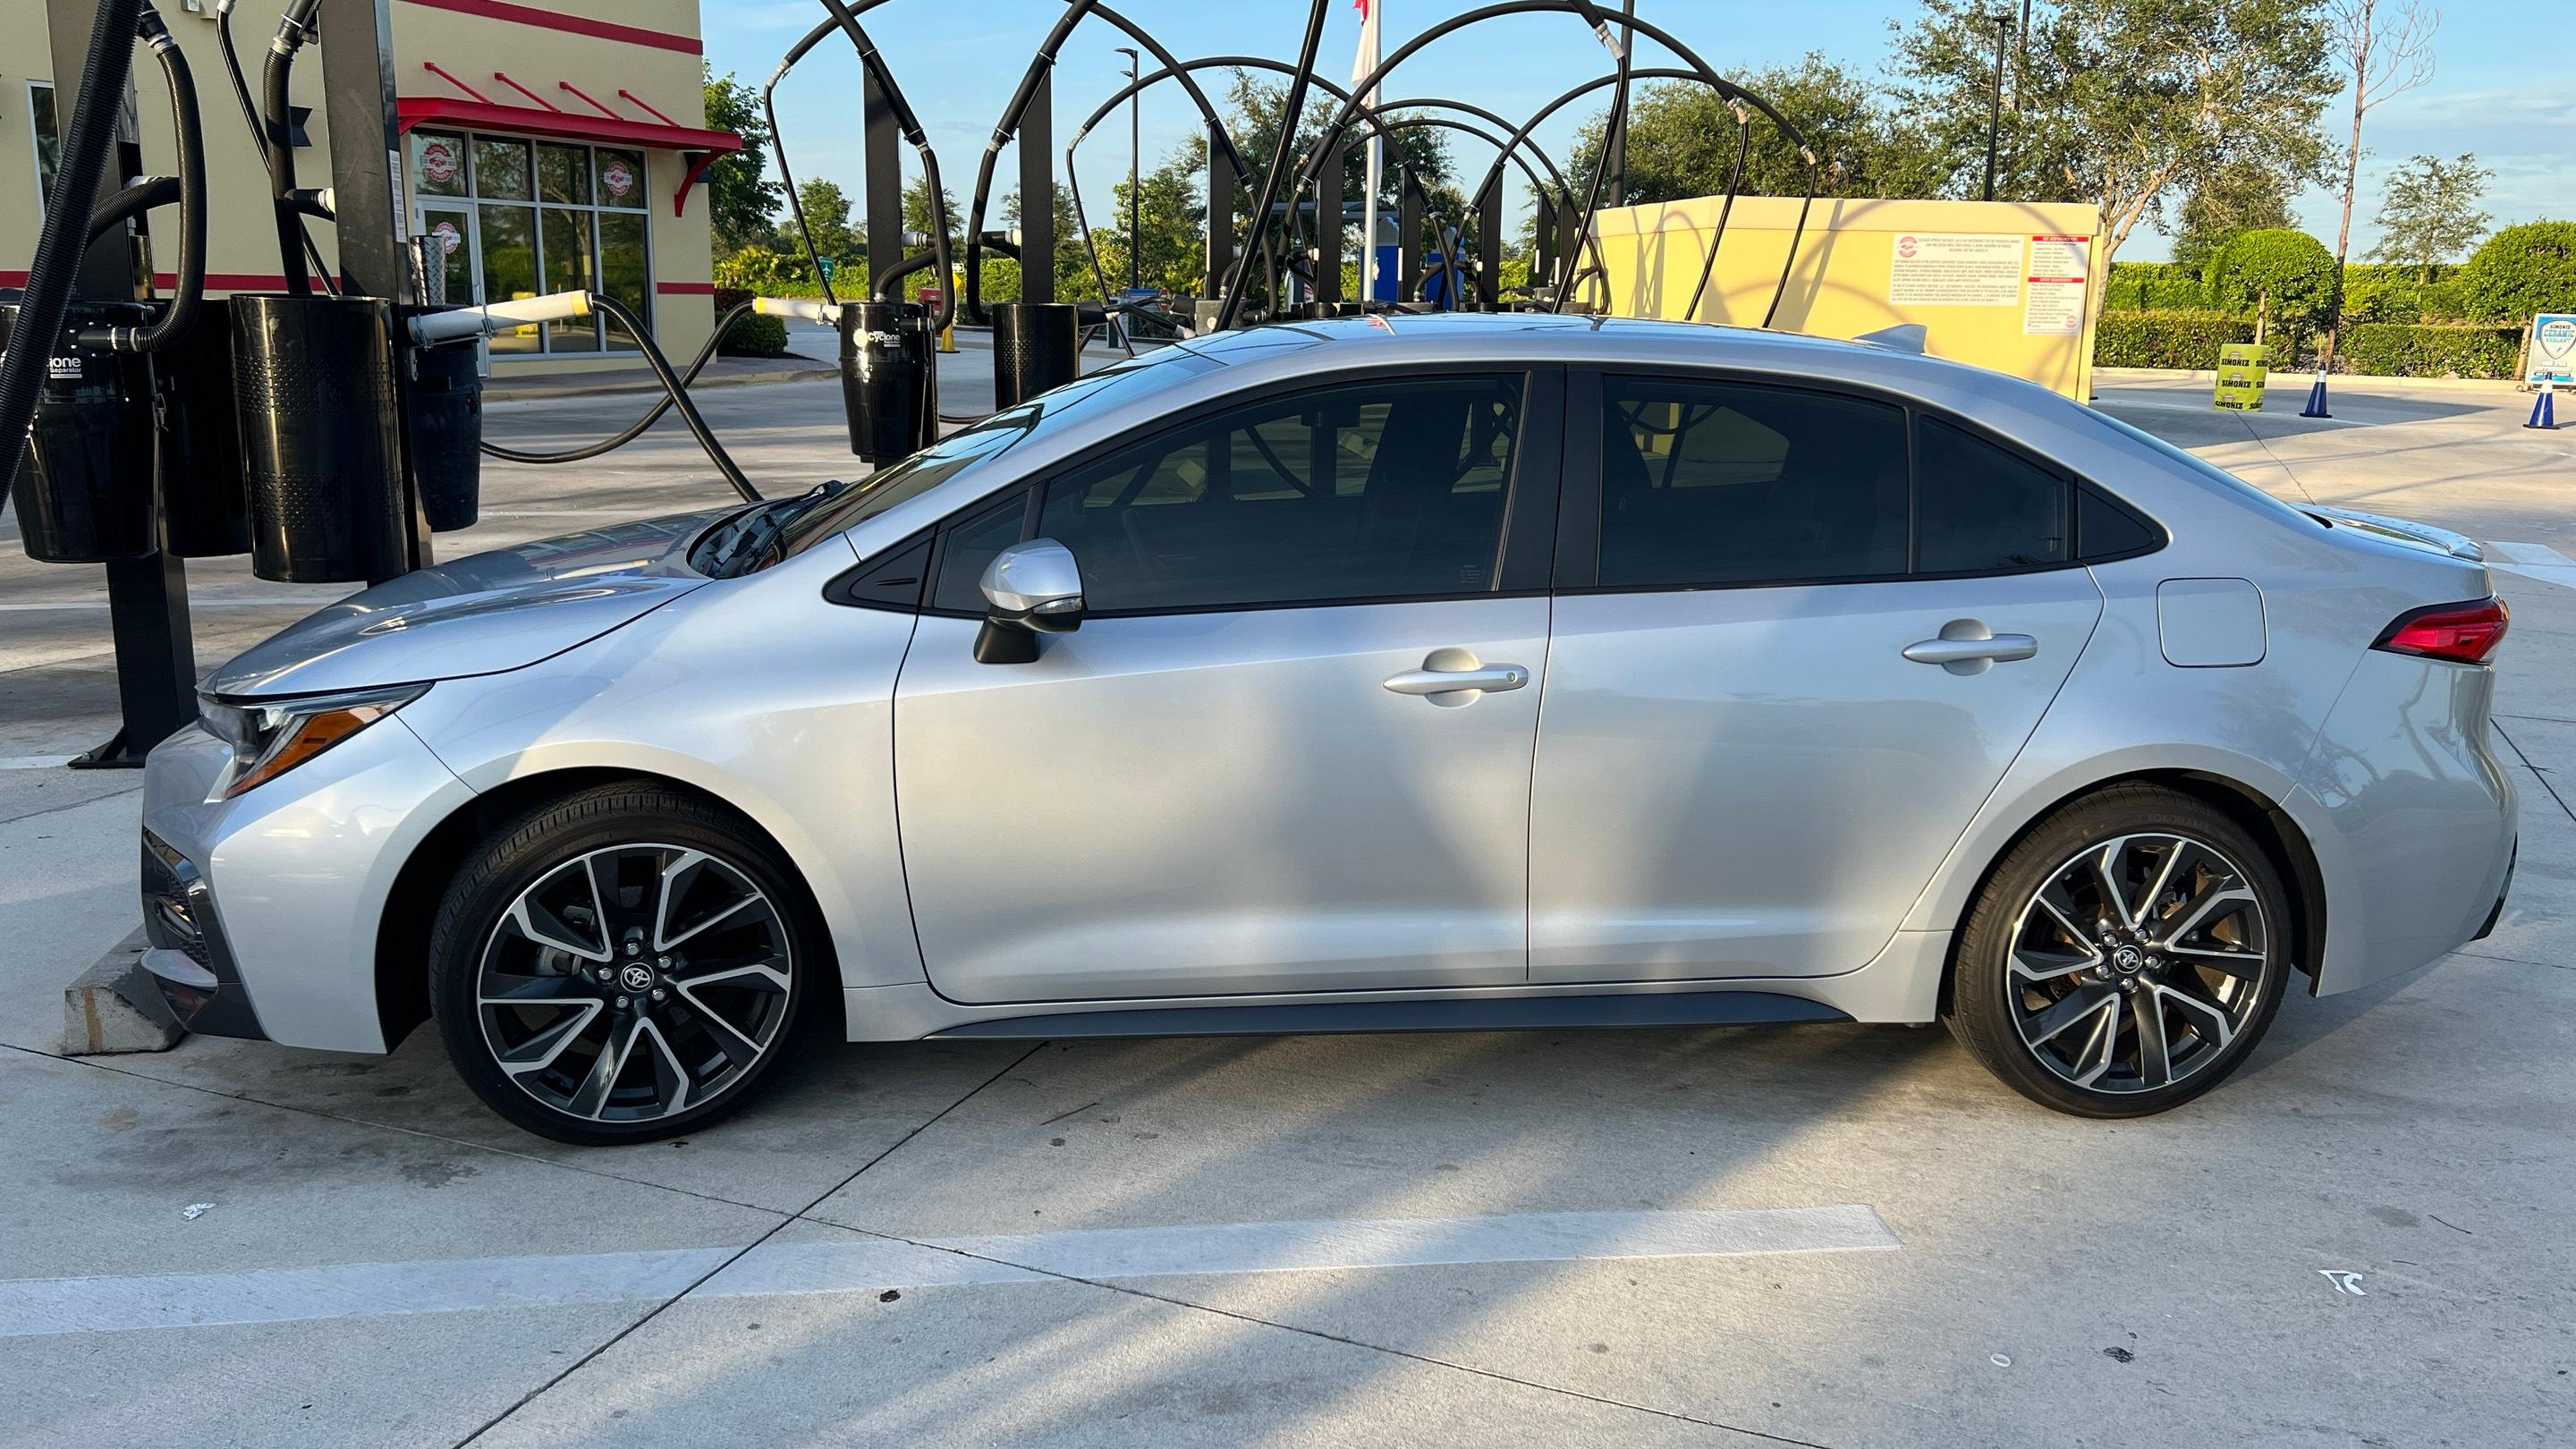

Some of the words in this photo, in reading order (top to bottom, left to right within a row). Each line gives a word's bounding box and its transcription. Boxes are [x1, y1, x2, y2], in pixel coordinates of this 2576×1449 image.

[2544, 329, 2574, 337] CERAMIC
[868, 332, 900, 343] Cyclone
[2221, 359, 2250, 367] SIMONIZ
[2222, 380, 2251, 388] SIMONIZ
[2215, 401, 2243, 409] SIMONIZ
